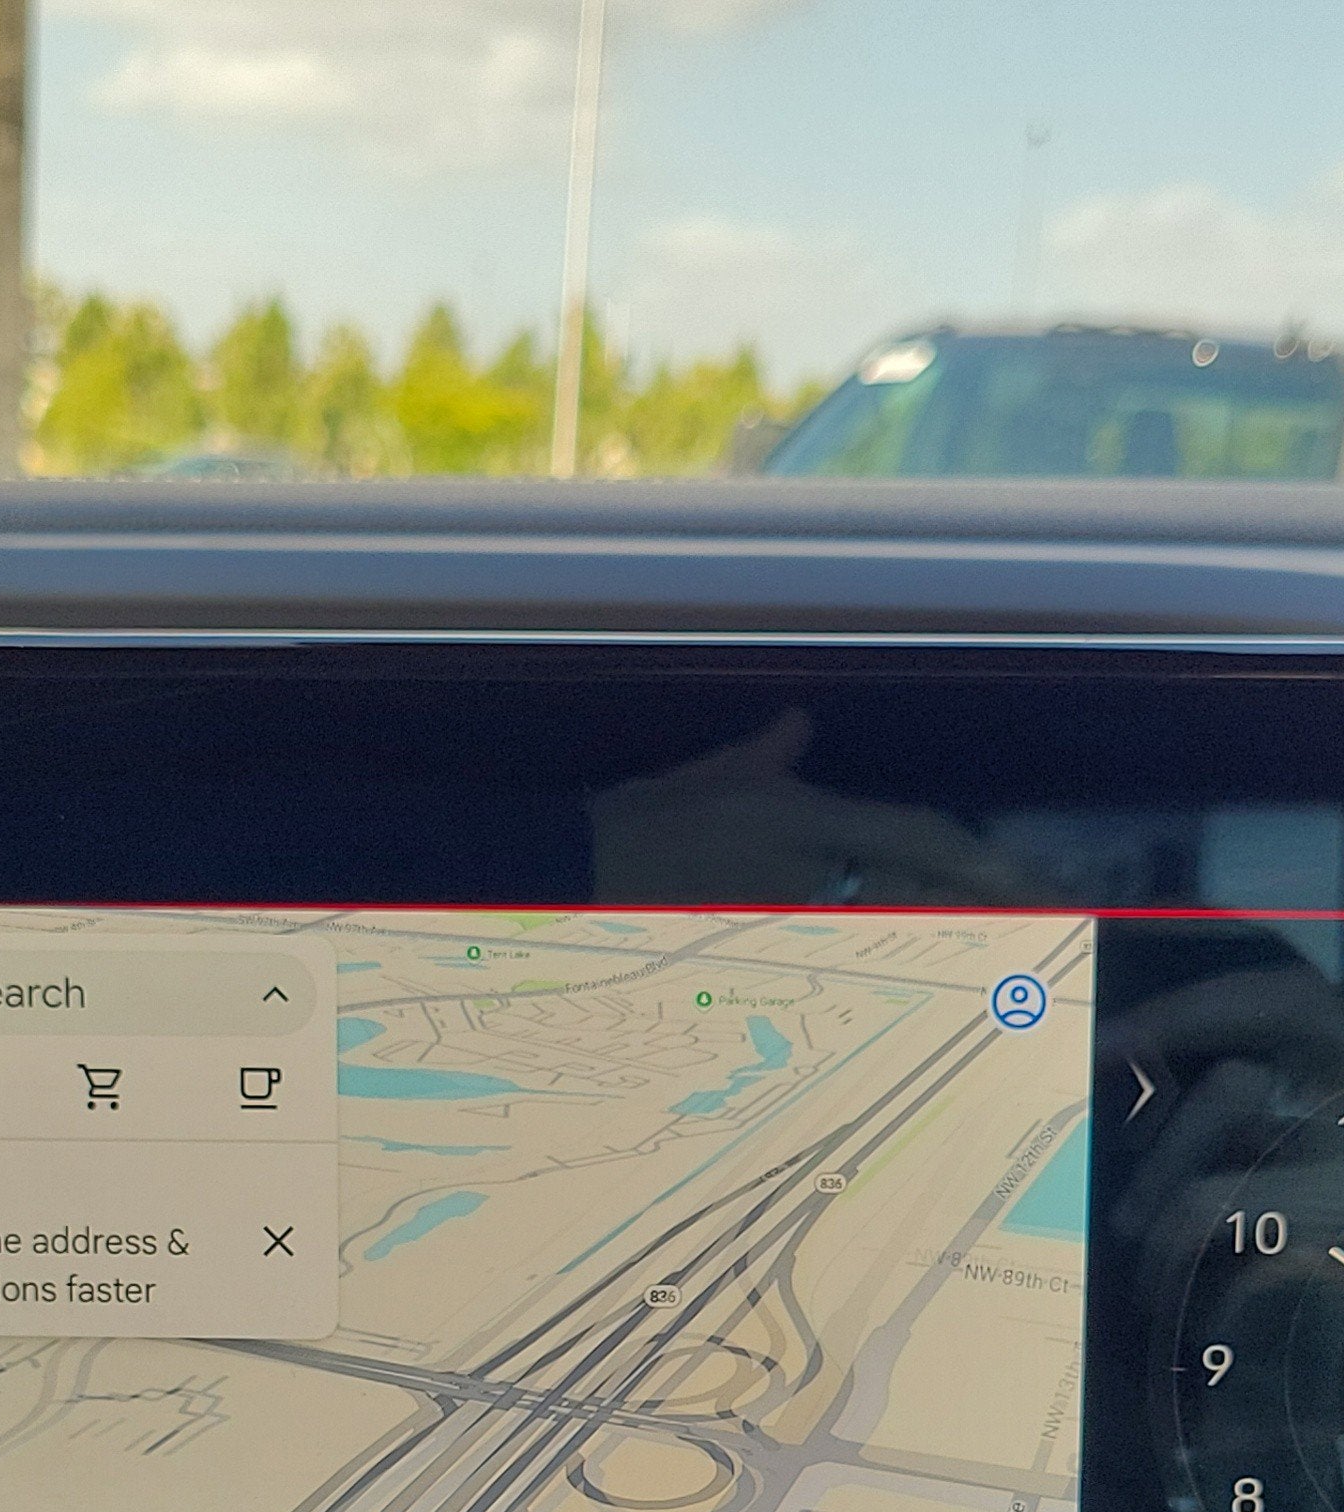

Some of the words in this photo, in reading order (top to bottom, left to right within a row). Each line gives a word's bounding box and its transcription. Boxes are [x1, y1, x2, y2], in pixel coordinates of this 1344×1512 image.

[995, 1171, 1019, 1199] NW
[1015, 1146, 1042, 1172] 12th
[1040, 1126, 1057, 1145] St
[32, 1225, 157, 1255] address
[167, 1228, 190, 1256] &
[1225, 1211, 1288, 1256] 10
[66, 1273, 157, 1303] faster
[964, 1262, 997, 1283] NW
[1002, 1268, 1043, 1290] 89th
[1048, 1276, 1069, 1294] Ct
[1201, 1345, 1235, 1388] 9
